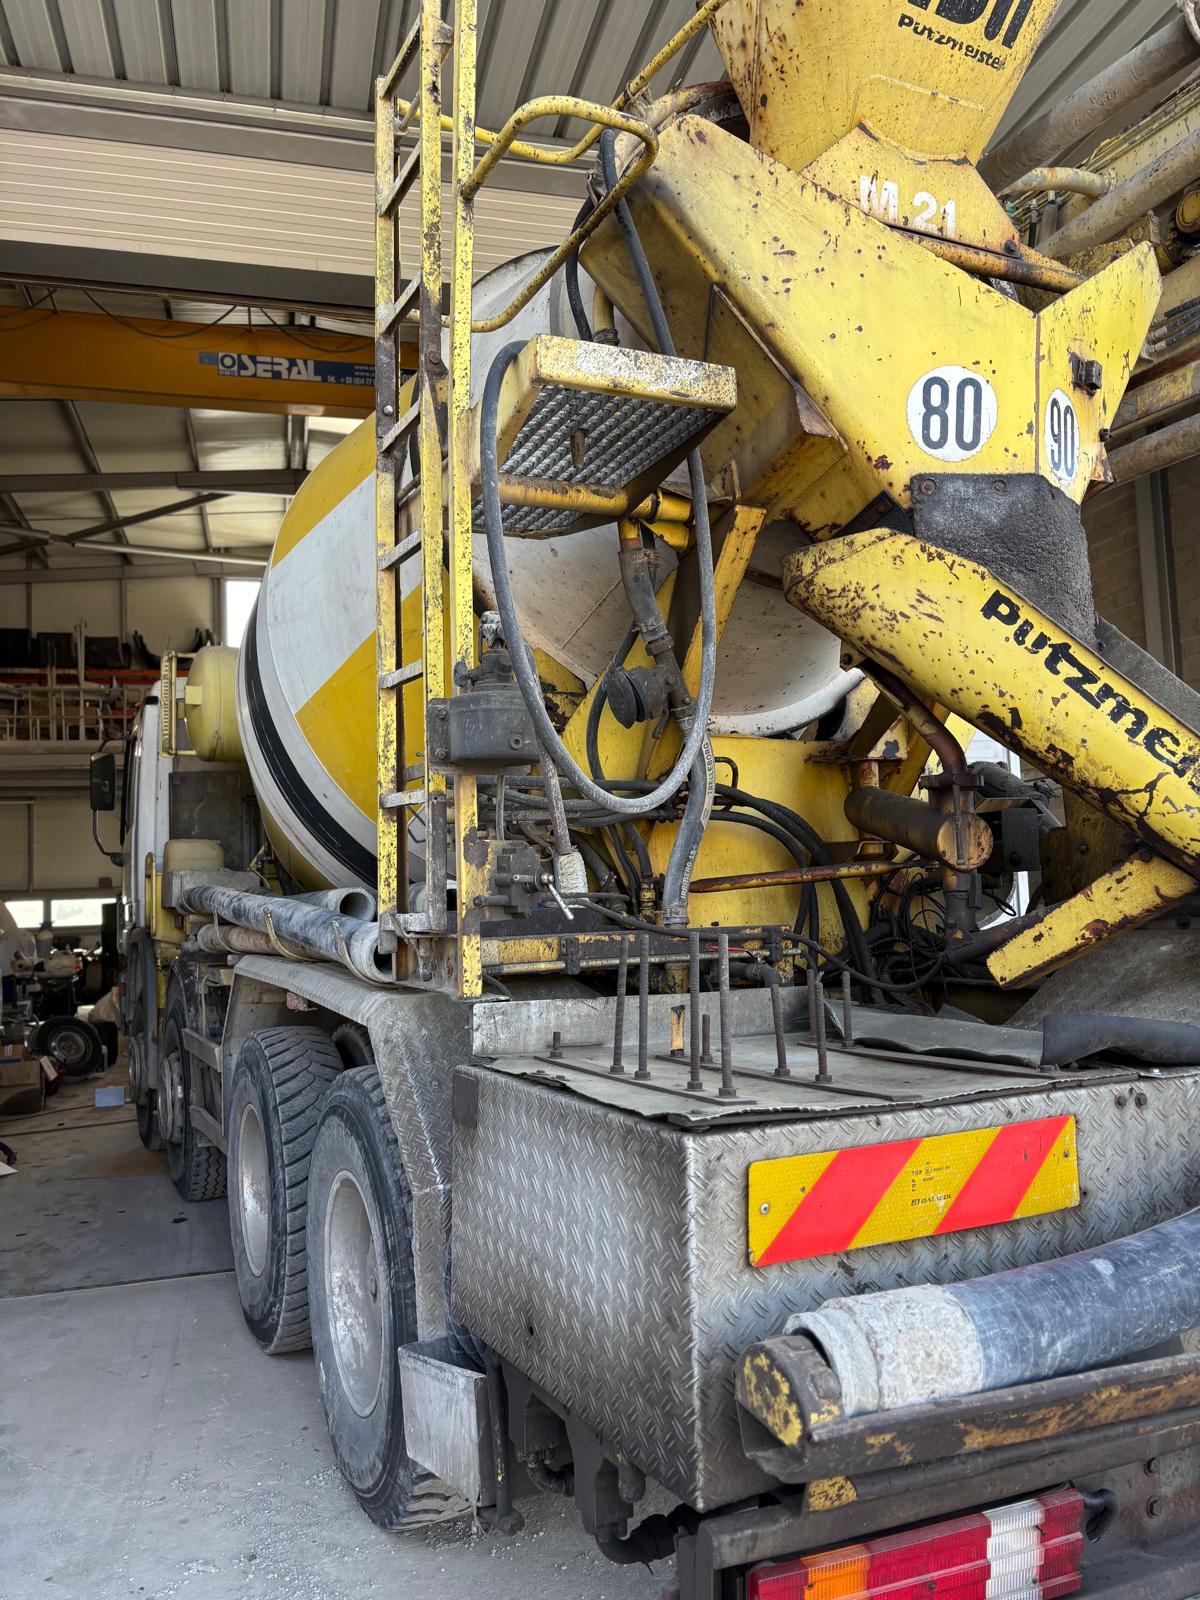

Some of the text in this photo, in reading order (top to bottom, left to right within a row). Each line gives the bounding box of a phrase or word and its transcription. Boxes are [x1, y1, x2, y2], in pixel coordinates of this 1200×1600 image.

[860, 176, 956, 240] M 21
[240, 354, 322, 382] SERAL
[922, 376, 982, 451] 80
[1050, 397, 1075, 477] 90
[703, 742, 714, 796] TRELLEBORG
